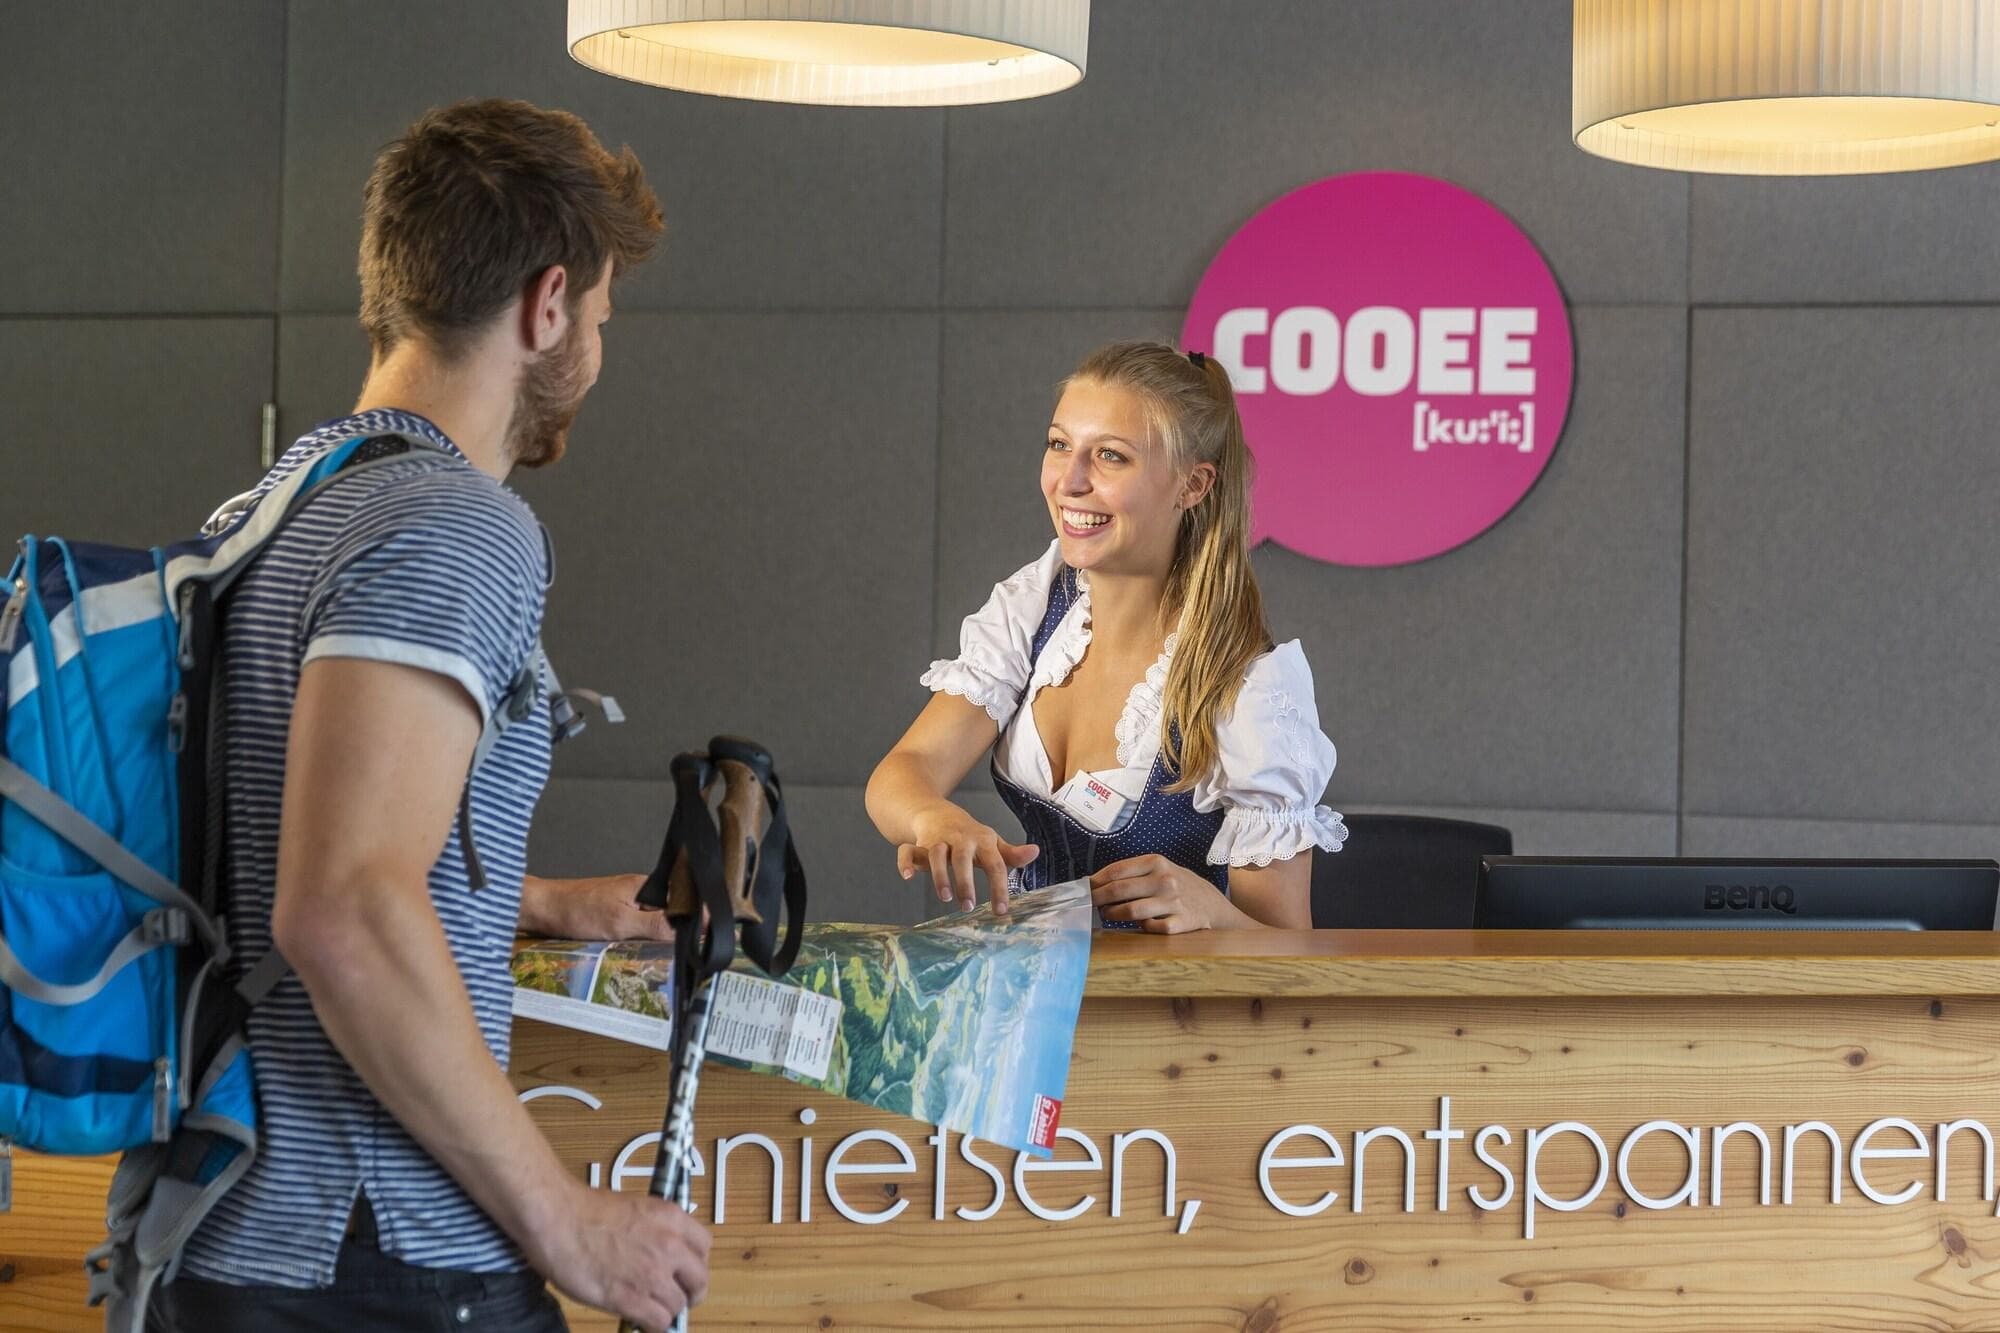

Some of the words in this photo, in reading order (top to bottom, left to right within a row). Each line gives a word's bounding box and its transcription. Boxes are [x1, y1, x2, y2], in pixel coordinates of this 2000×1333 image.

[1213, 306, 1538, 395] COOEE
[1087, 780, 1112, 800] COOEE
[1704, 884, 1797, 914] BenQ
